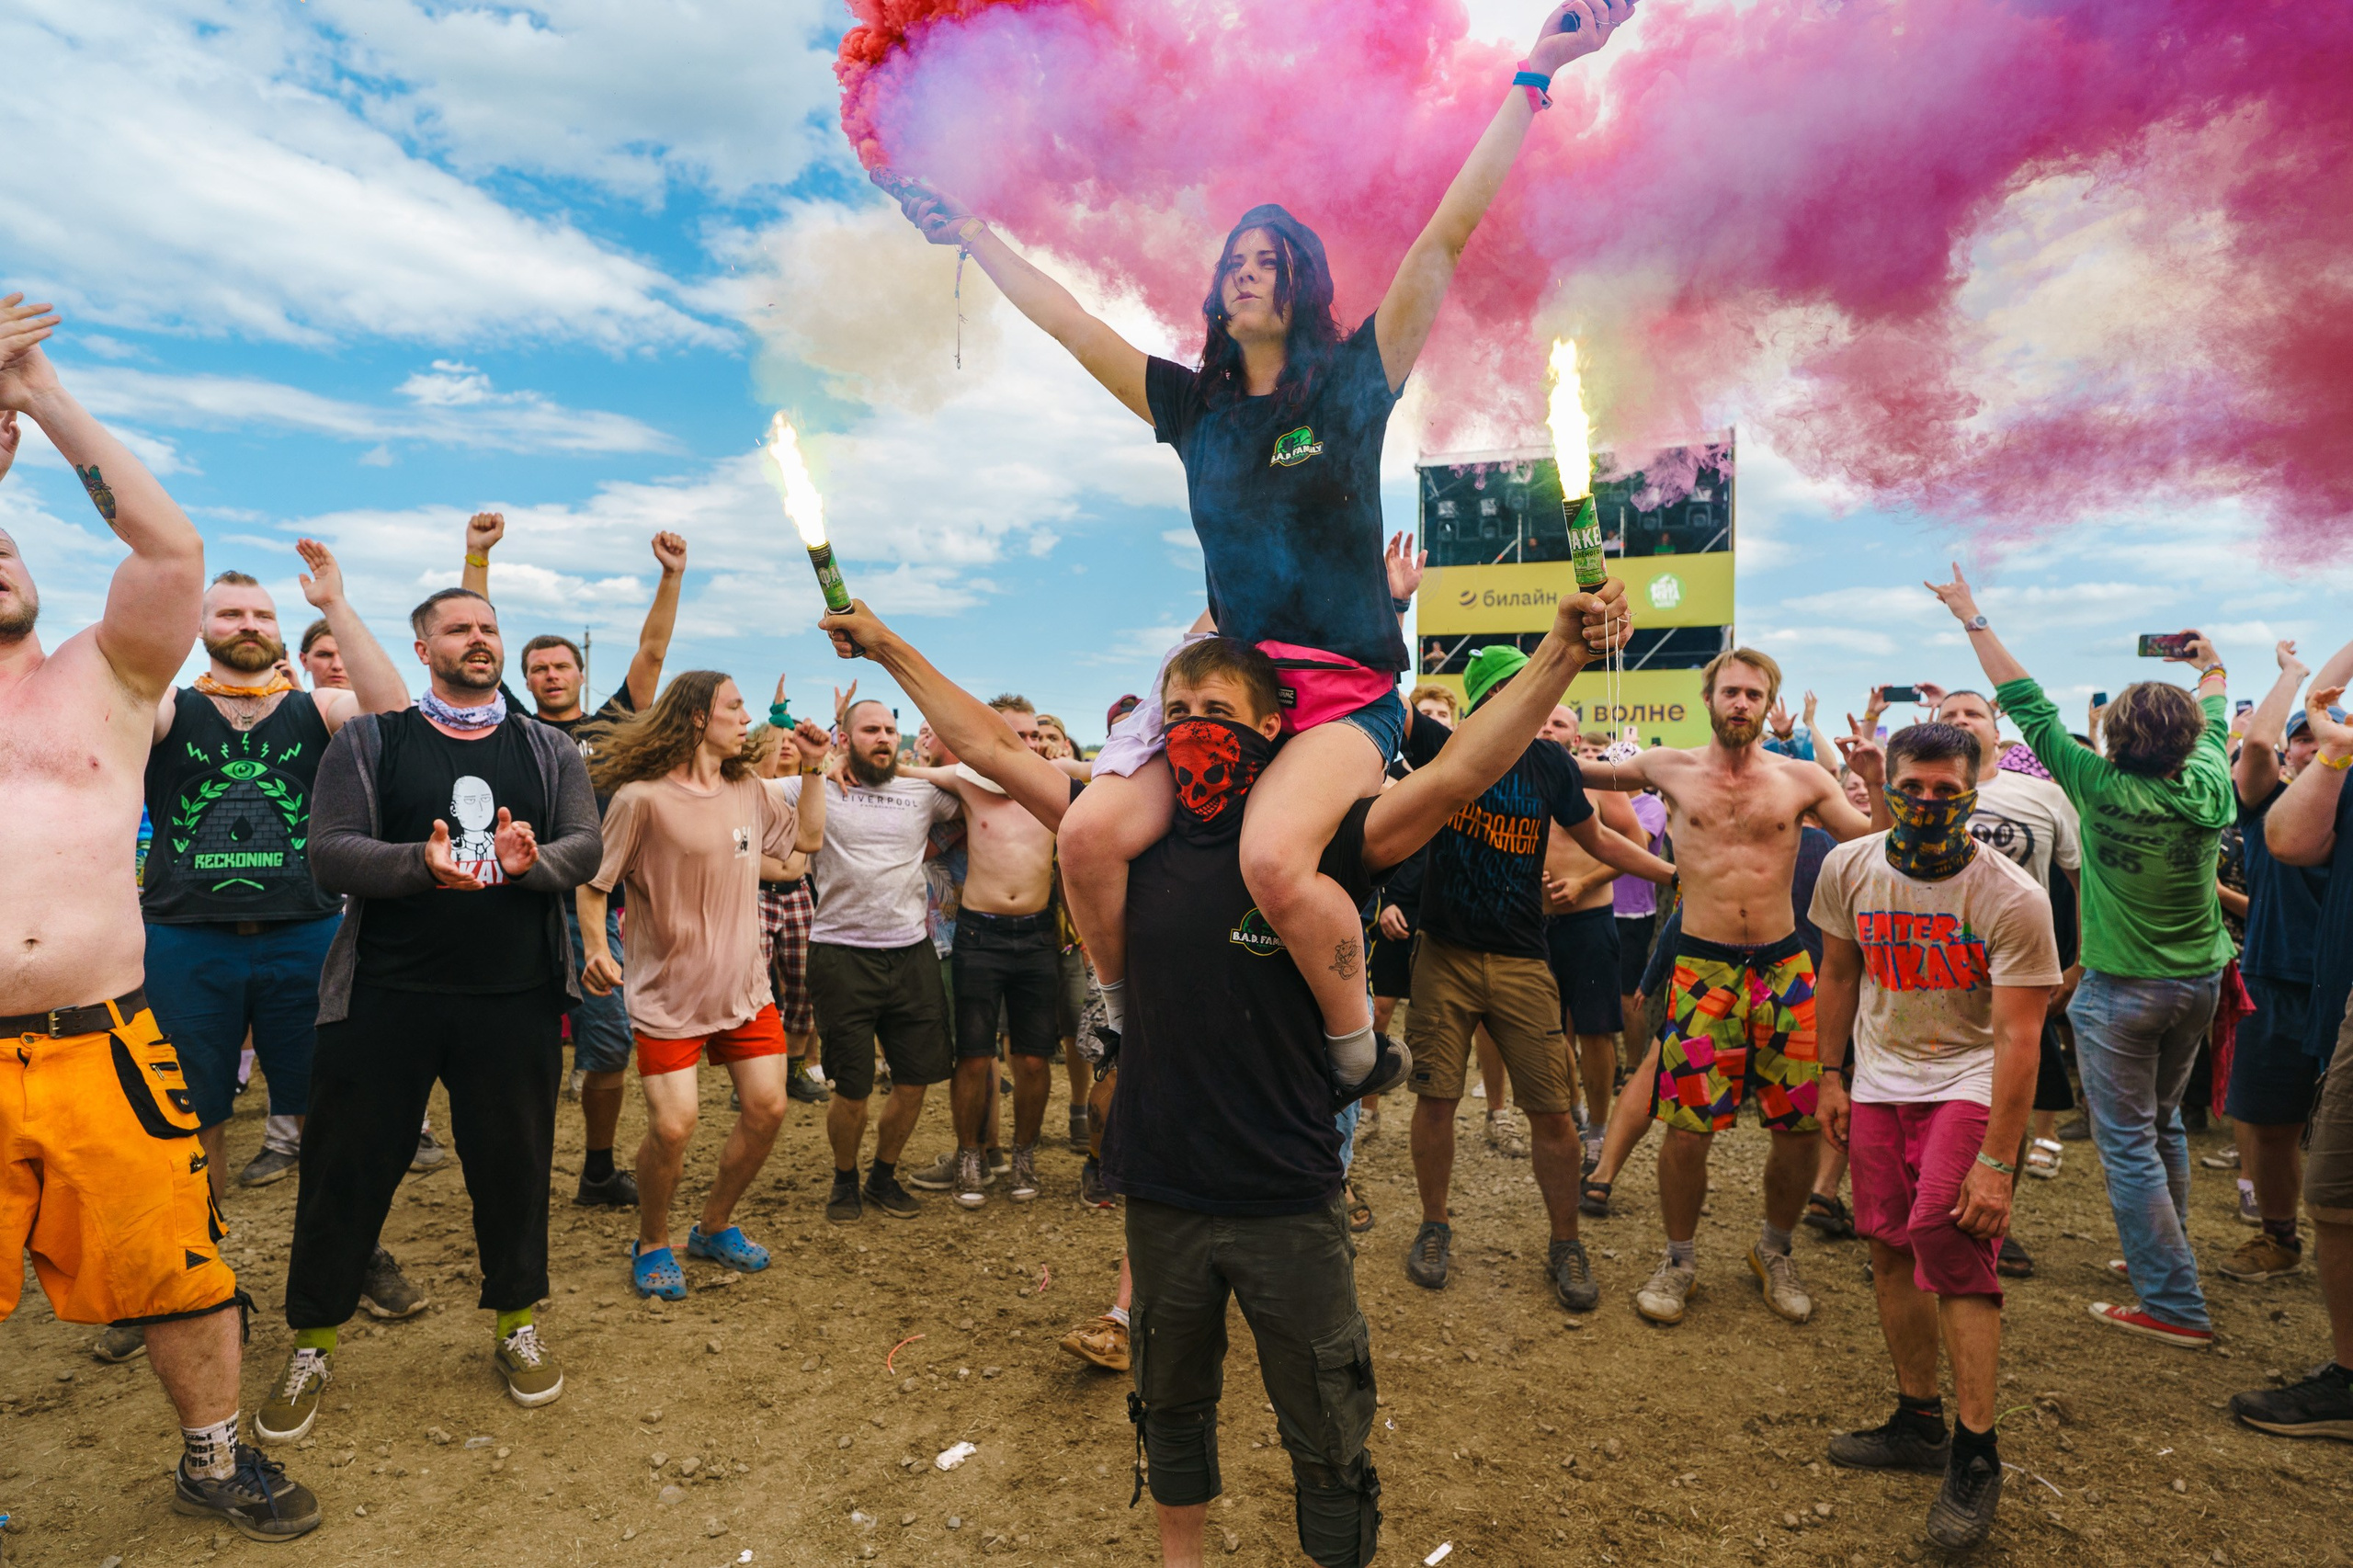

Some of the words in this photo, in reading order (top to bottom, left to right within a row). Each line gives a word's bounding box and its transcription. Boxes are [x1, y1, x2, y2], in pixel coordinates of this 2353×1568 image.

[1483, 588, 1558, 608] билайн
[1595, 704, 1685, 722] волне
[841, 794, 918, 808] LIVERPOOL
[194, 851, 285, 870] RECKONING
[458, 860, 504, 885] KAY
[1232, 931, 1259, 945] B.A.D.
[1857, 911, 1958, 946] ENTER
